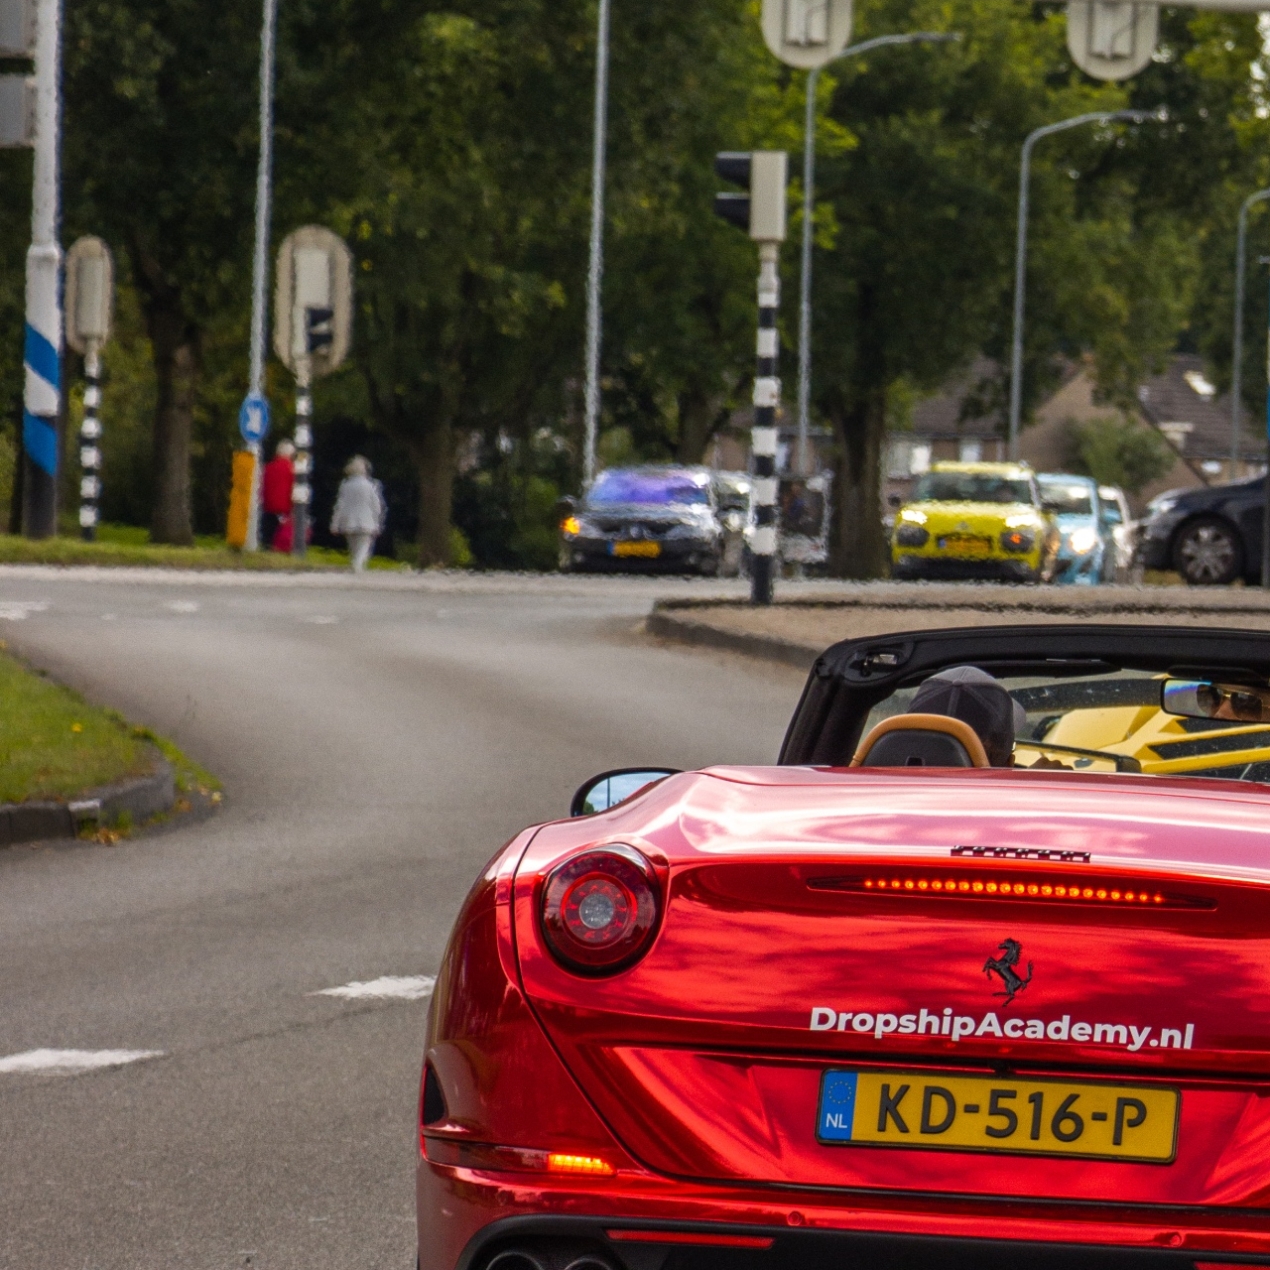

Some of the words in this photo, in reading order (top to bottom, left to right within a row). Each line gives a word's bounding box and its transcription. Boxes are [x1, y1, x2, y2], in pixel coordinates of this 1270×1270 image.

[809, 1006, 1195, 1051] DropshipAcademy.nl
[825, 1113, 848, 1129] NL
[876, 1083, 1148, 1146] KD-516-P
